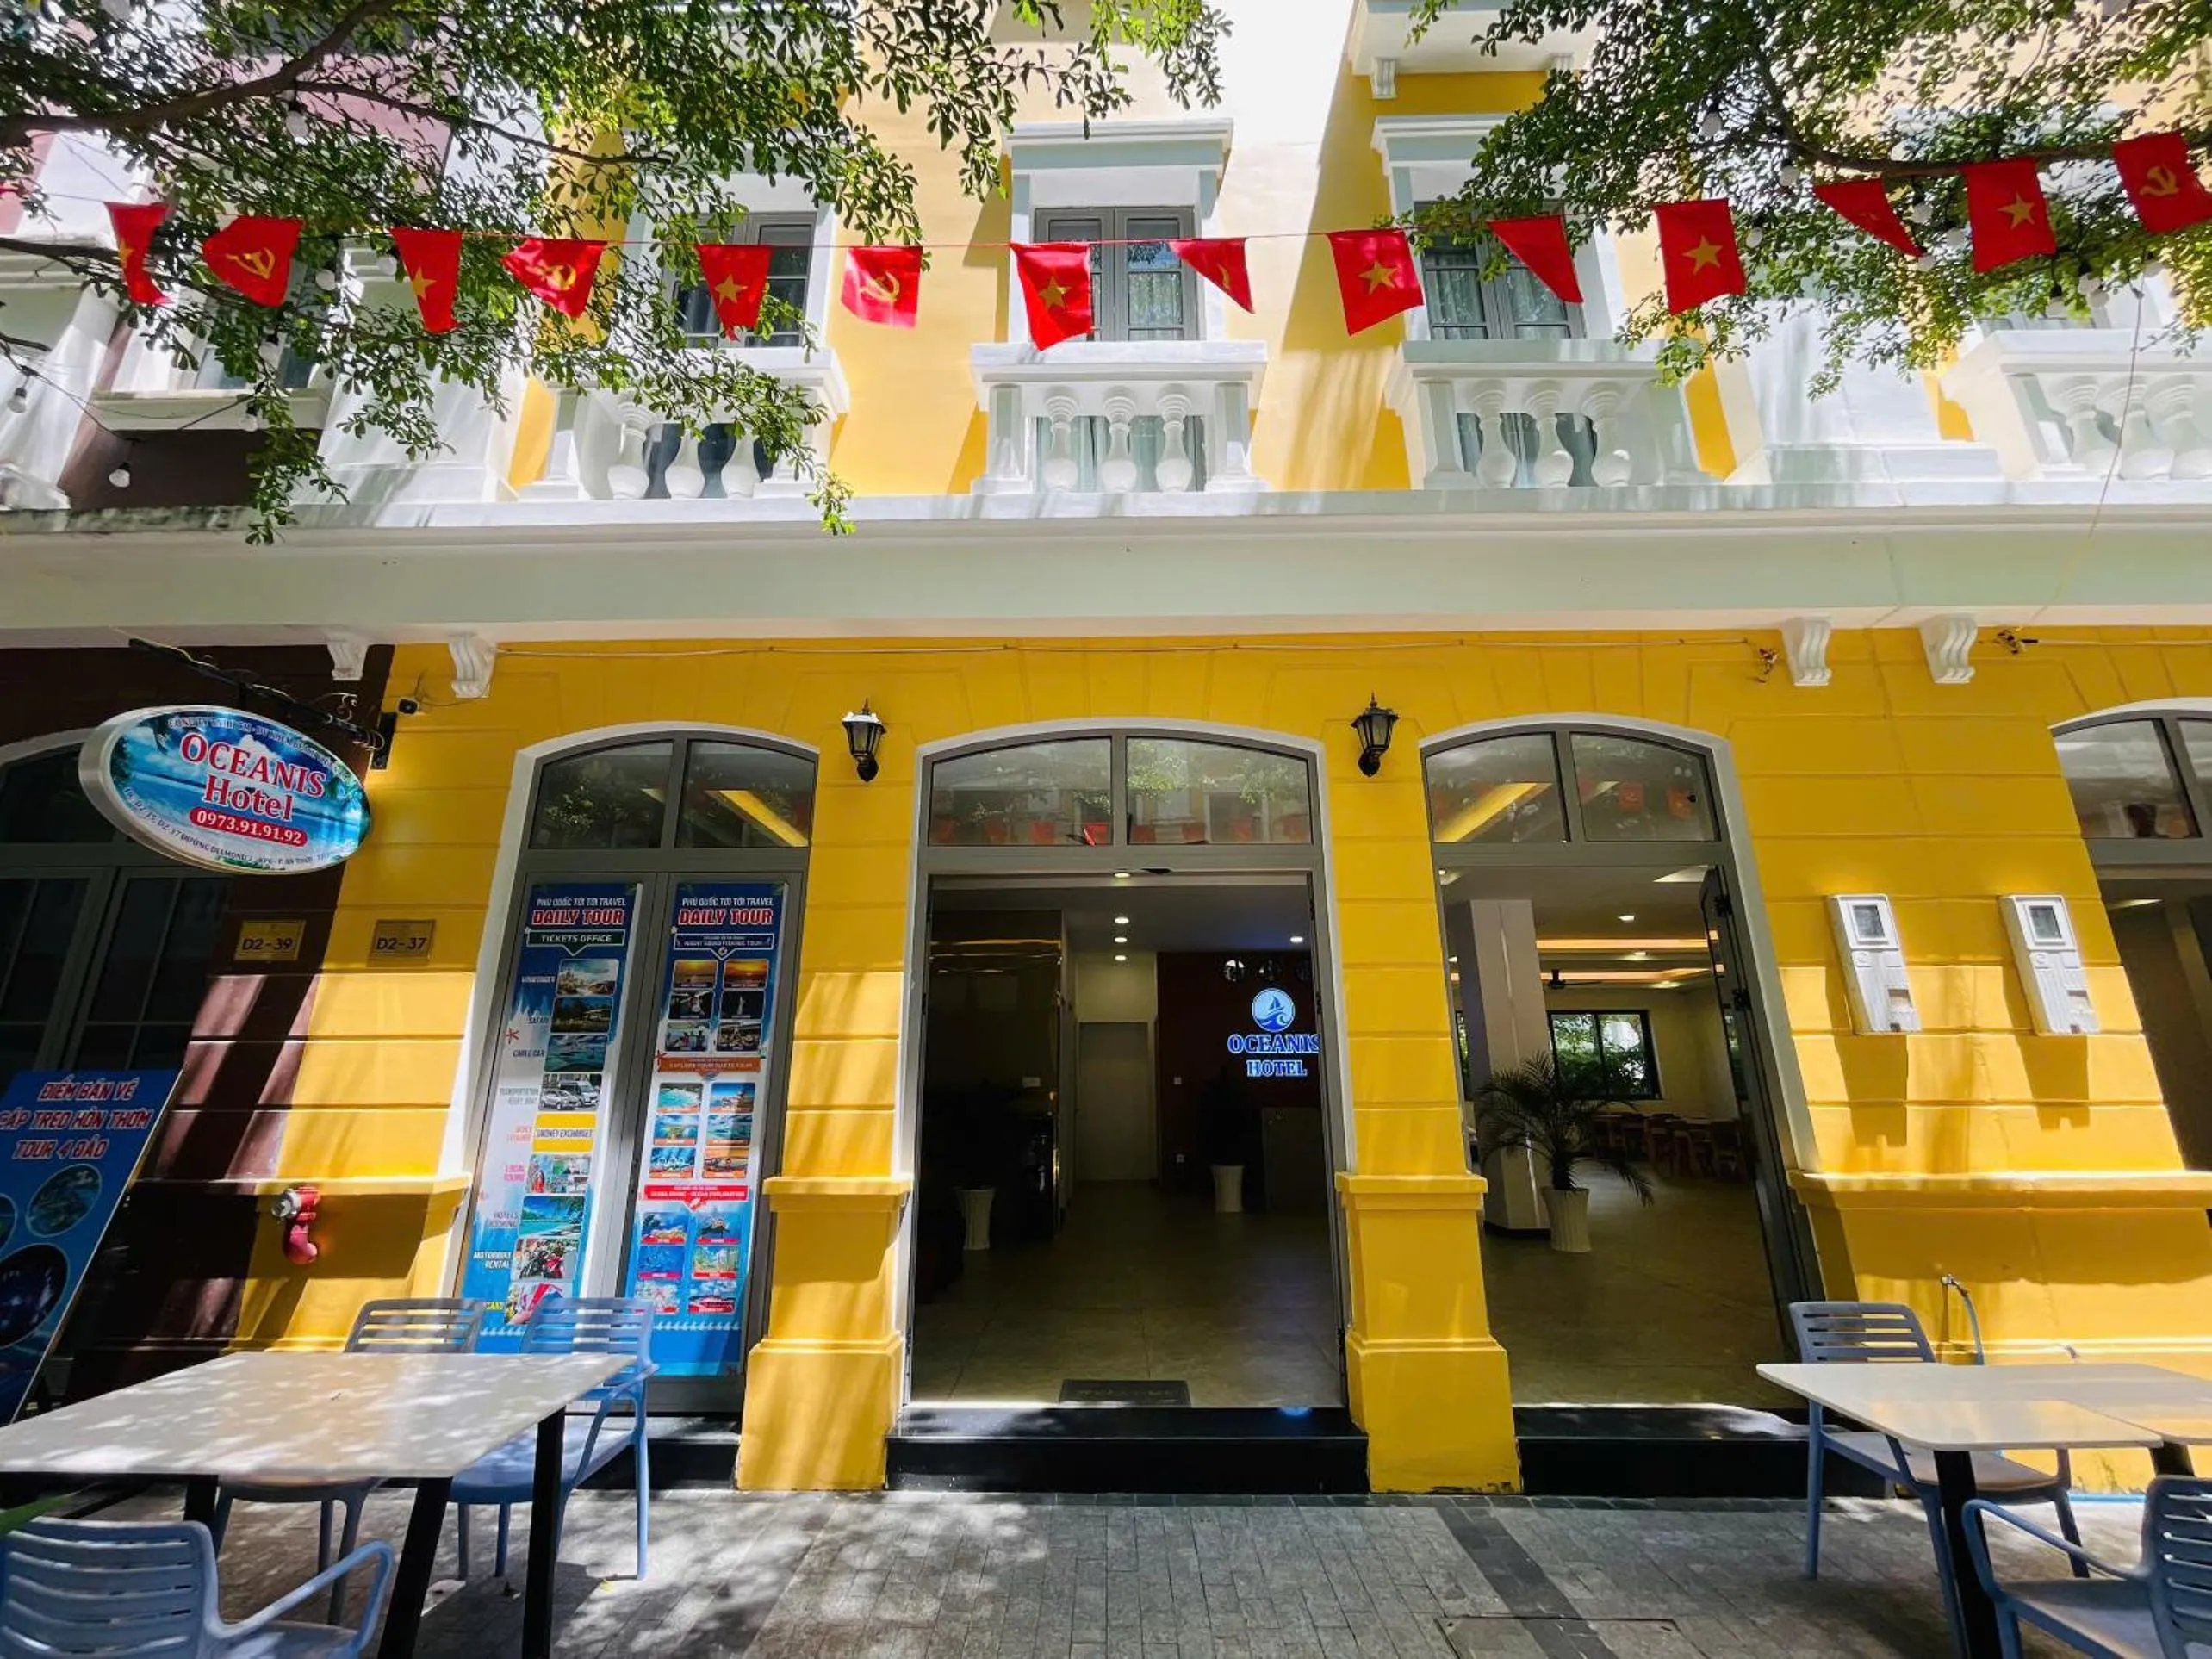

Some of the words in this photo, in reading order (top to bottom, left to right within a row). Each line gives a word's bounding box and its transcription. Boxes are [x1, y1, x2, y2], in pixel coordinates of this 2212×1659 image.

[180, 732, 327, 798] OCEANIS
[202, 774, 294, 822] Hotel
[196, 810, 303, 845] 0973.91.91.92
[531, 909, 581, 926] DAILY
[581, 908, 625, 926] TOUR
[678, 908, 726, 926] DAILY
[729, 908, 774, 926] TOUR
[541, 935, 578, 943] TICKETS
[580, 935, 612, 943] OFFICE
[1227, 1034, 1320, 1053] OCEANIS
[1246, 1059, 1308, 1077] HOTEL
[29, 1109, 73, 1130] TREO
[12, 1139, 59, 1159] TOUR
[56, 1139, 74, 1160] 4
